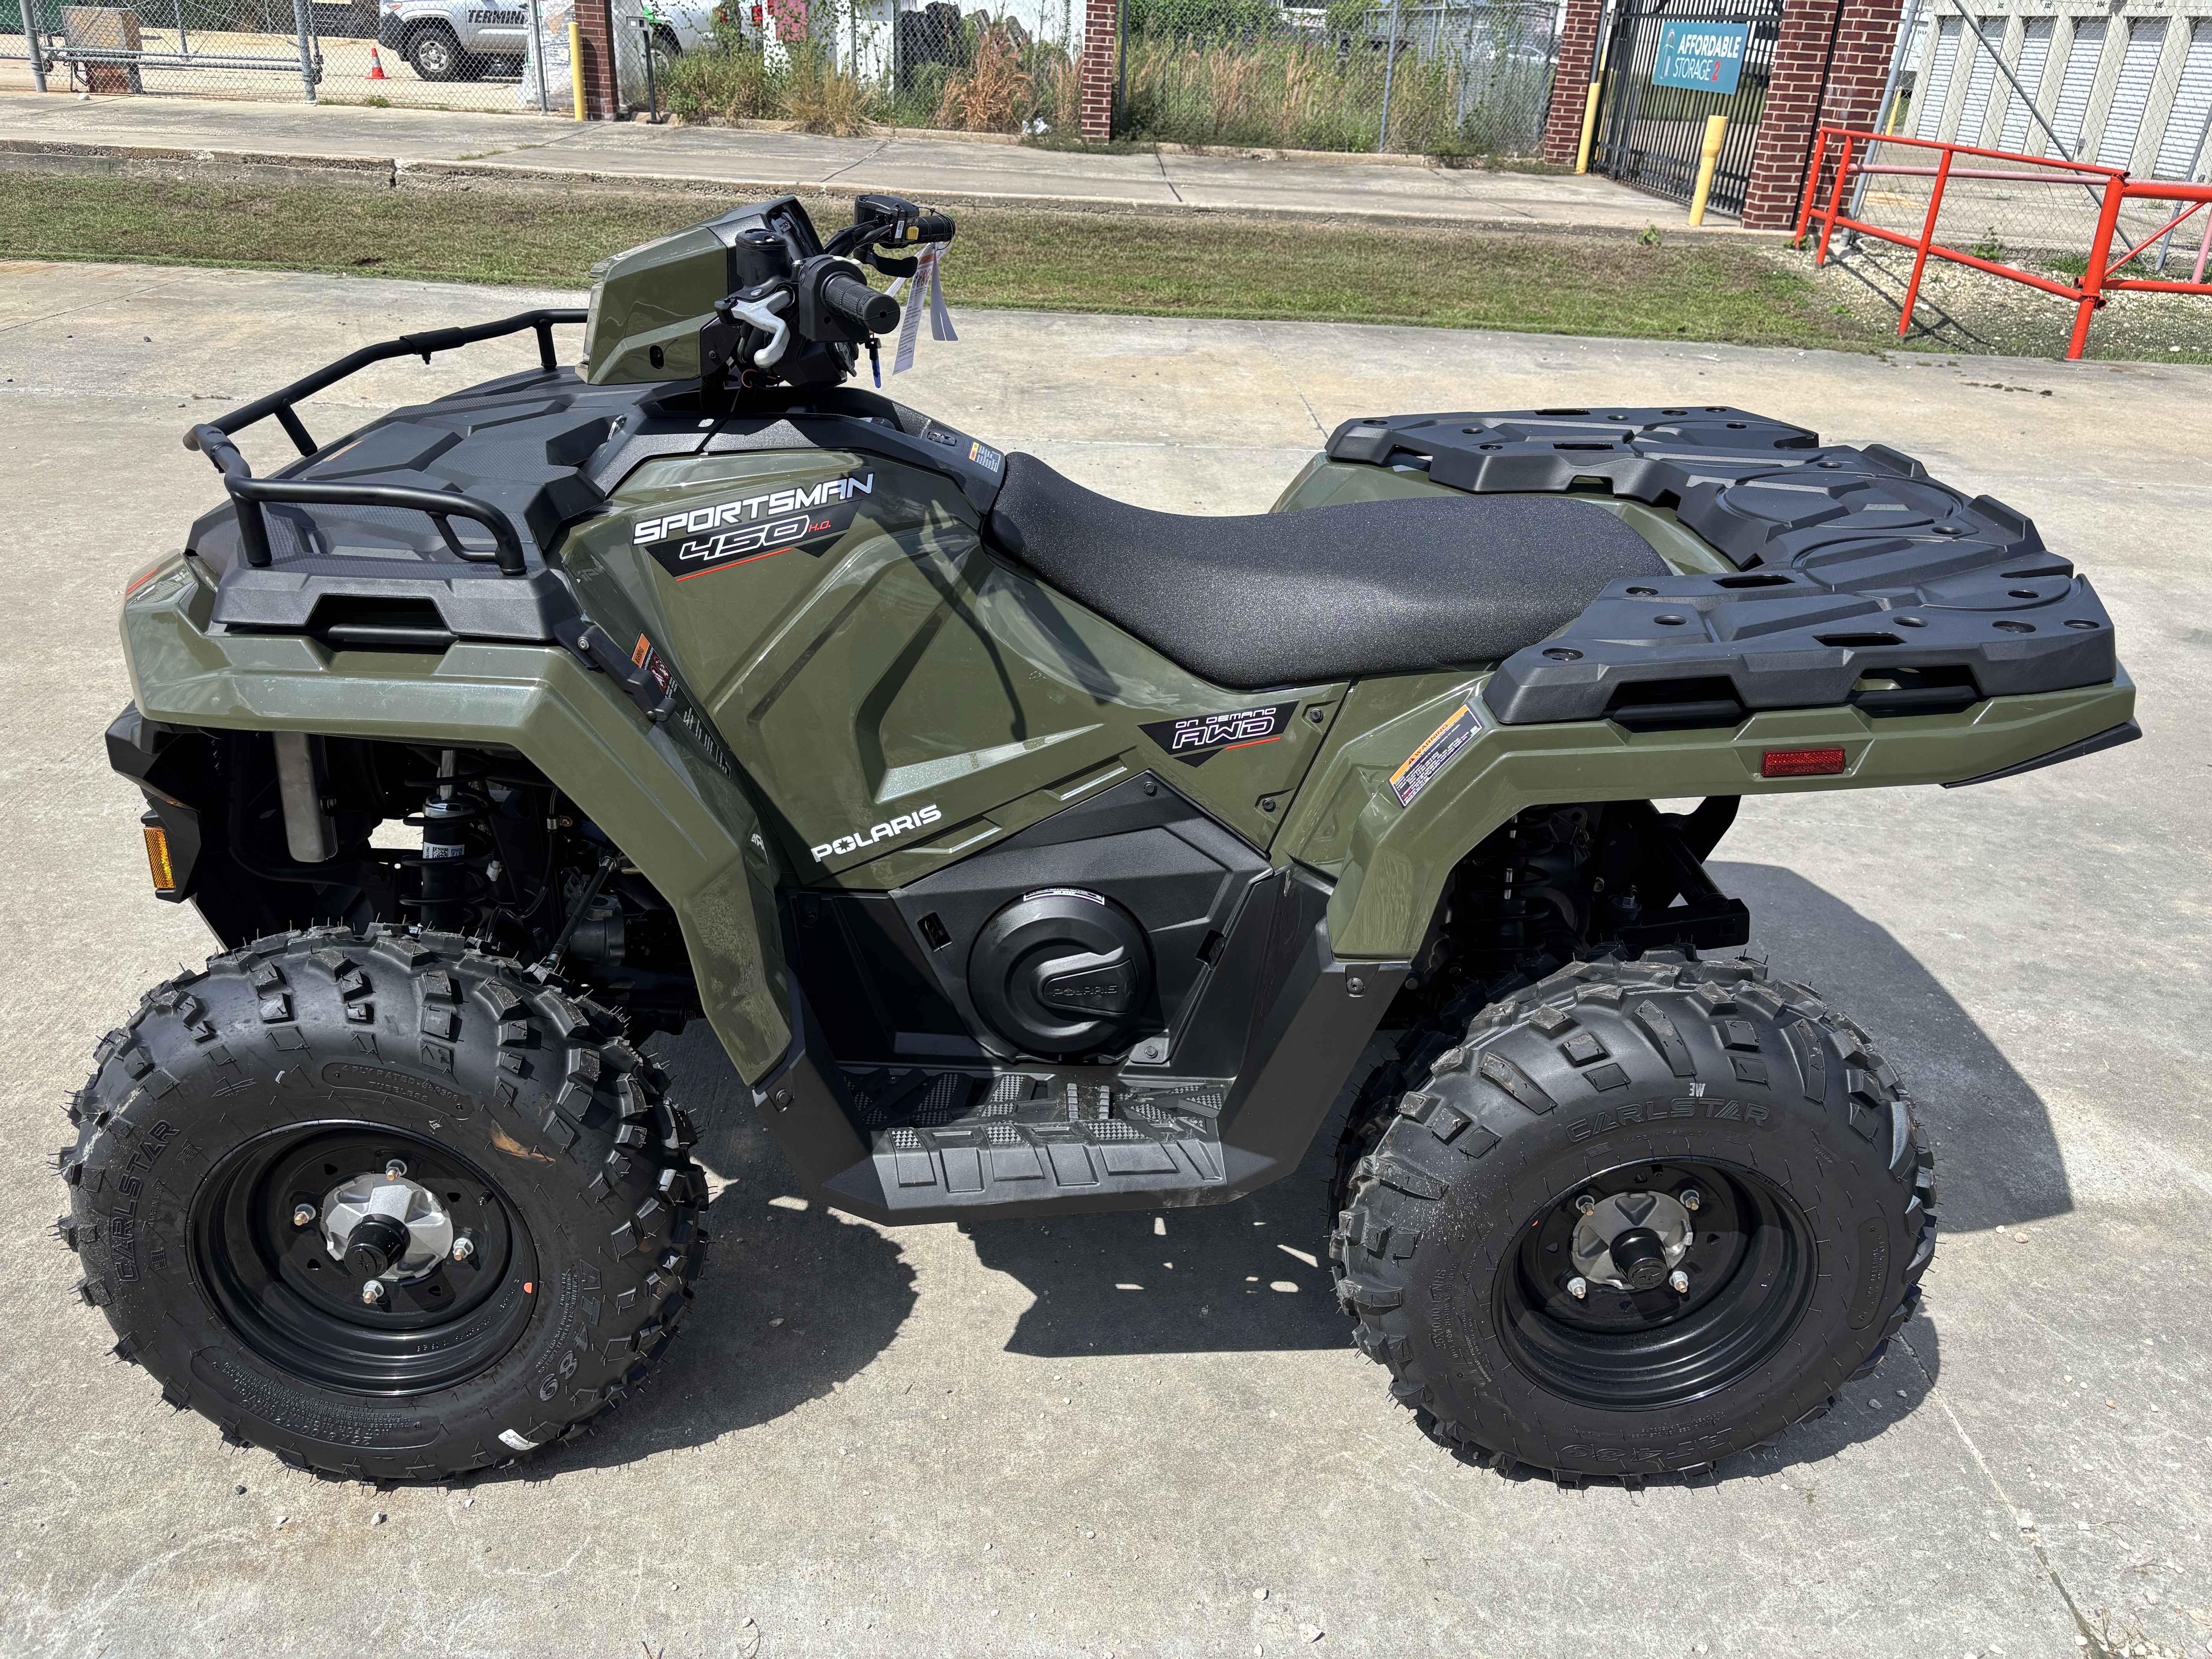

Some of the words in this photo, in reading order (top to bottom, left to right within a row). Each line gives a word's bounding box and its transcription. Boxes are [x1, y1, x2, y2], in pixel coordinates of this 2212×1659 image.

[1677, 34, 1741, 58] AFFORDABLE
[1673, 57, 1713, 81] STORAGE
[1711, 60, 1721, 81] 2
[634, 473, 874, 544] SPORTSMAN
[679, 514, 810, 560] 450
[809, 520, 831, 532] H.O.
[1175, 719, 1191, 728] ON
[1214, 707, 1276, 723] DEMAND
[1172, 716, 1274, 750] AWD
[1414, 723, 1449, 757] WARNING
[811, 804, 942, 862] POLARIS
[1053, 985, 1117, 997] POLARIS
[352, 1066, 373, 1075] PLY
[369, 1081, 429, 1102] TUBELESS
[1565, 1097, 1770, 1143] CARLSTAR
[110, 1119, 181, 1282] CARLSTAR
[1432, 1269, 1446, 1291] NHS
[538, 1259, 602, 1401] AT489
[239, 1398, 274, 1420] NHS
[281, 1410, 334, 1431] HIGHWAY
[292, 1407, 320, 1420] SERIOUS
[338, 1425, 361, 1435] FOR
[1559, 1428, 1732, 1462] AT489
